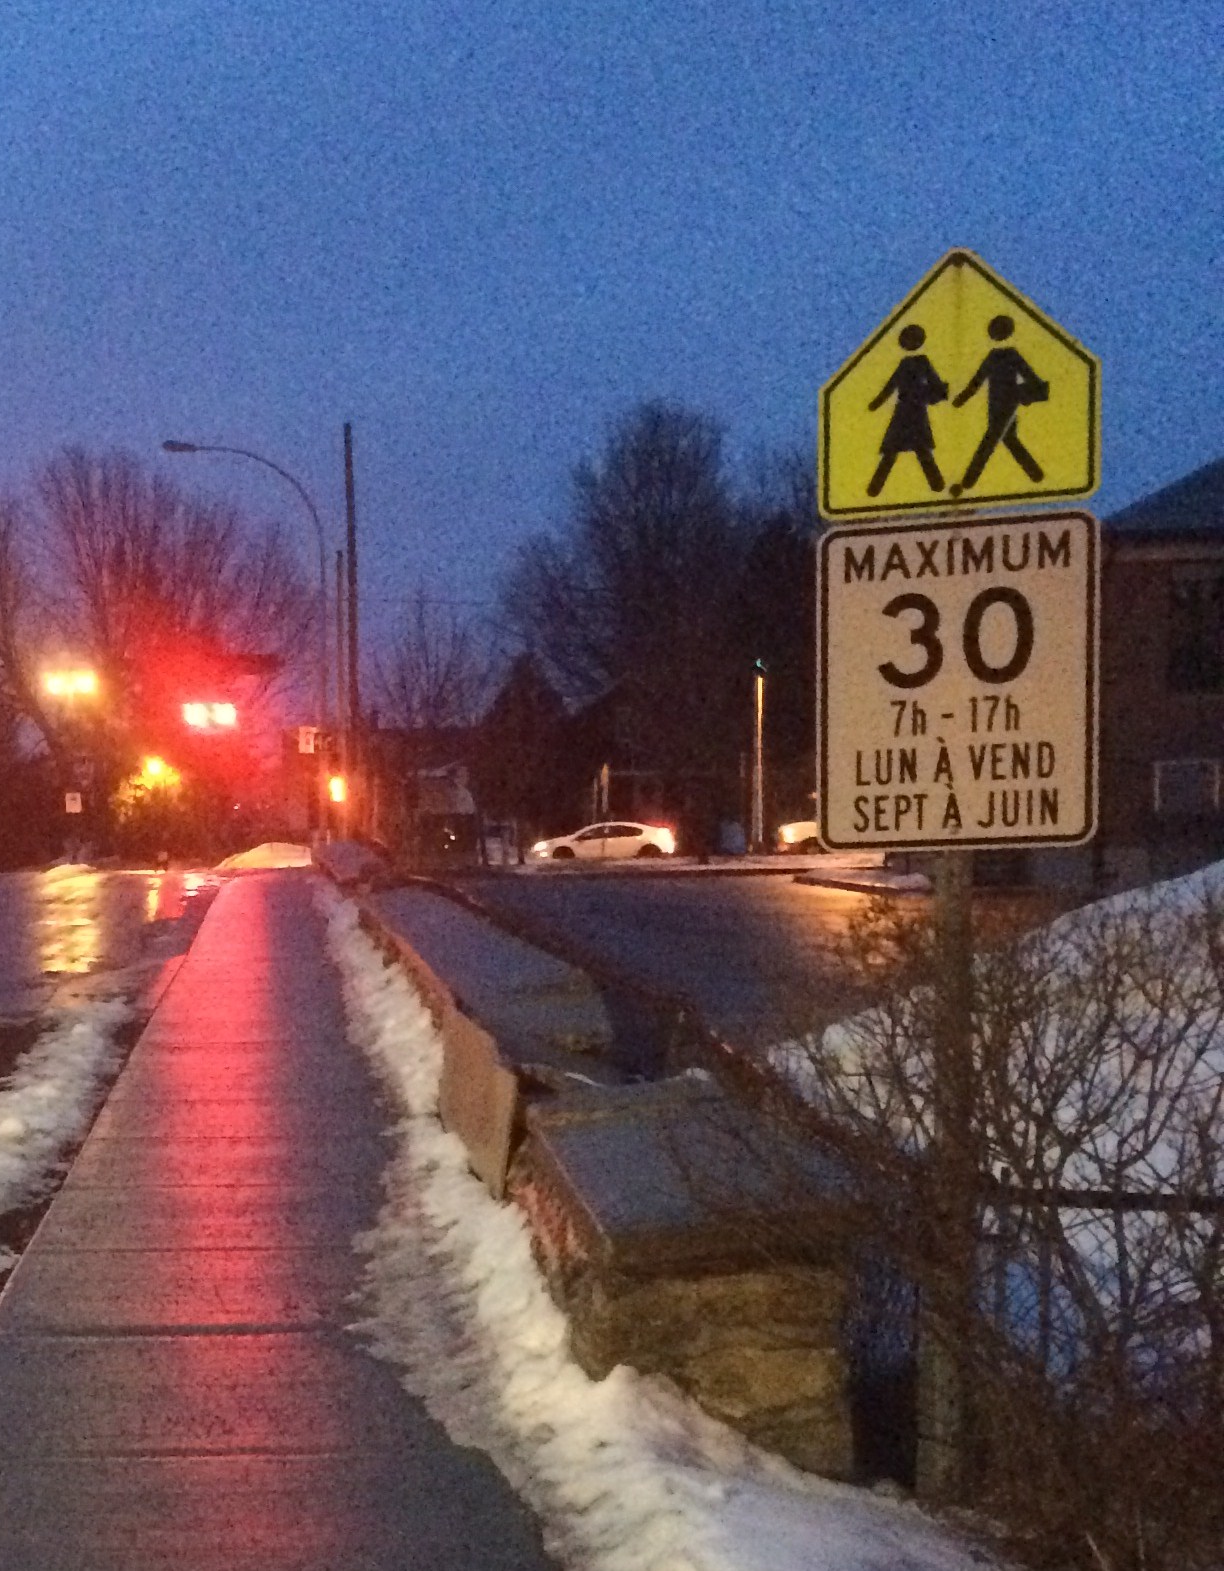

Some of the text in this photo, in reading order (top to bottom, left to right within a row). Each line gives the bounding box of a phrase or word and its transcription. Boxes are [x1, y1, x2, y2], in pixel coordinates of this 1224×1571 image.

[844, 530, 1071, 583] MAXIMUM
[879, 586, 1034, 688] 30
[890, 700, 926, 737] 7h
[970, 695, 1021, 732] 17h
[856, 736, 1055, 786] LUN À VEND
[854, 783, 1059, 832] SEPT À JUIN
